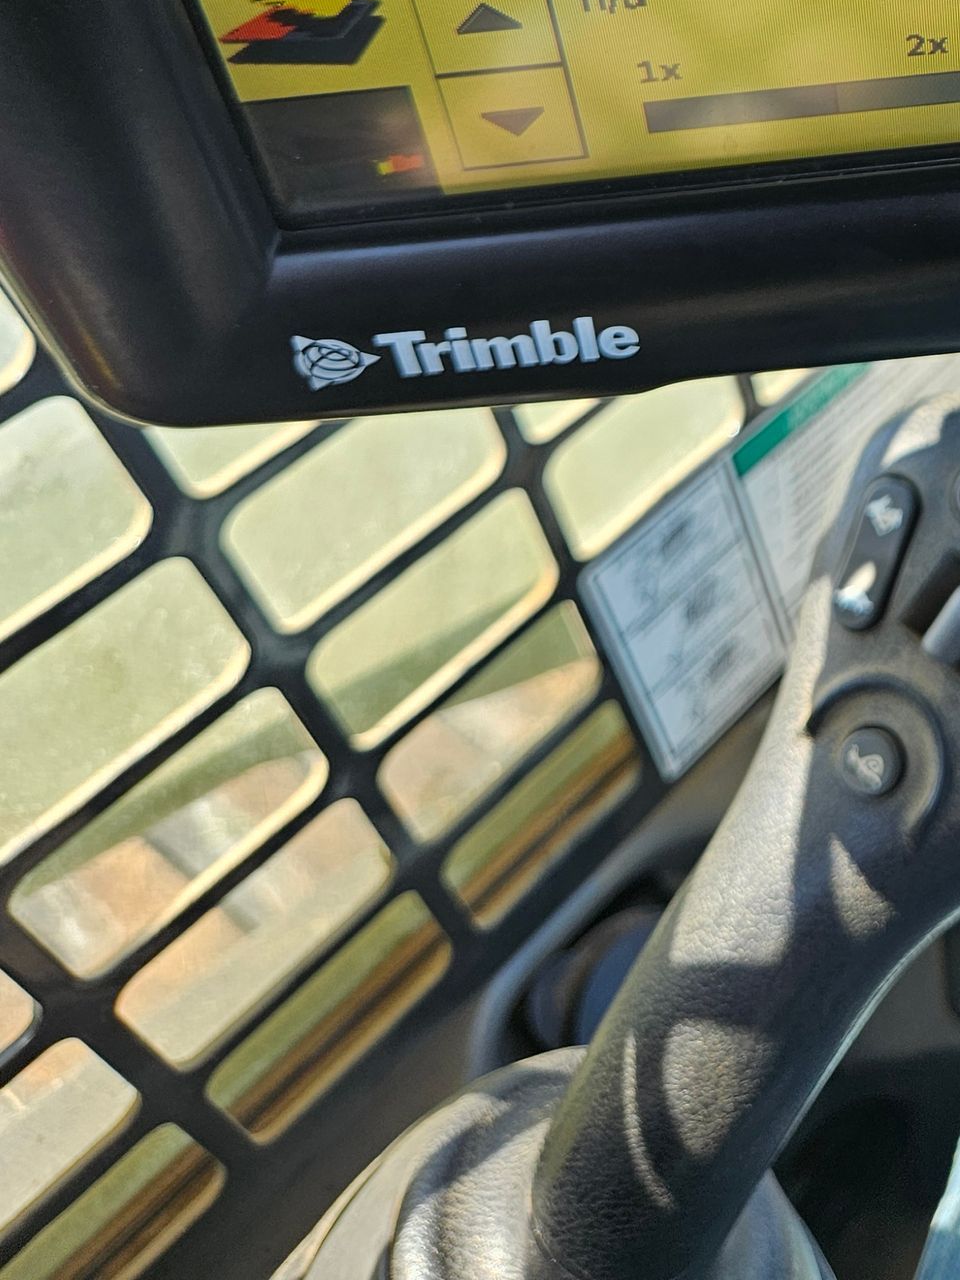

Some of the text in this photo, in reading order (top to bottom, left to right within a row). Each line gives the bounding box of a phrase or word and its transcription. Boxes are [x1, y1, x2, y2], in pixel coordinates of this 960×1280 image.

[906, 33, 949, 57] 2x
[637, 60, 683, 84] 1x
[373, 316, 641, 379] Trimble
